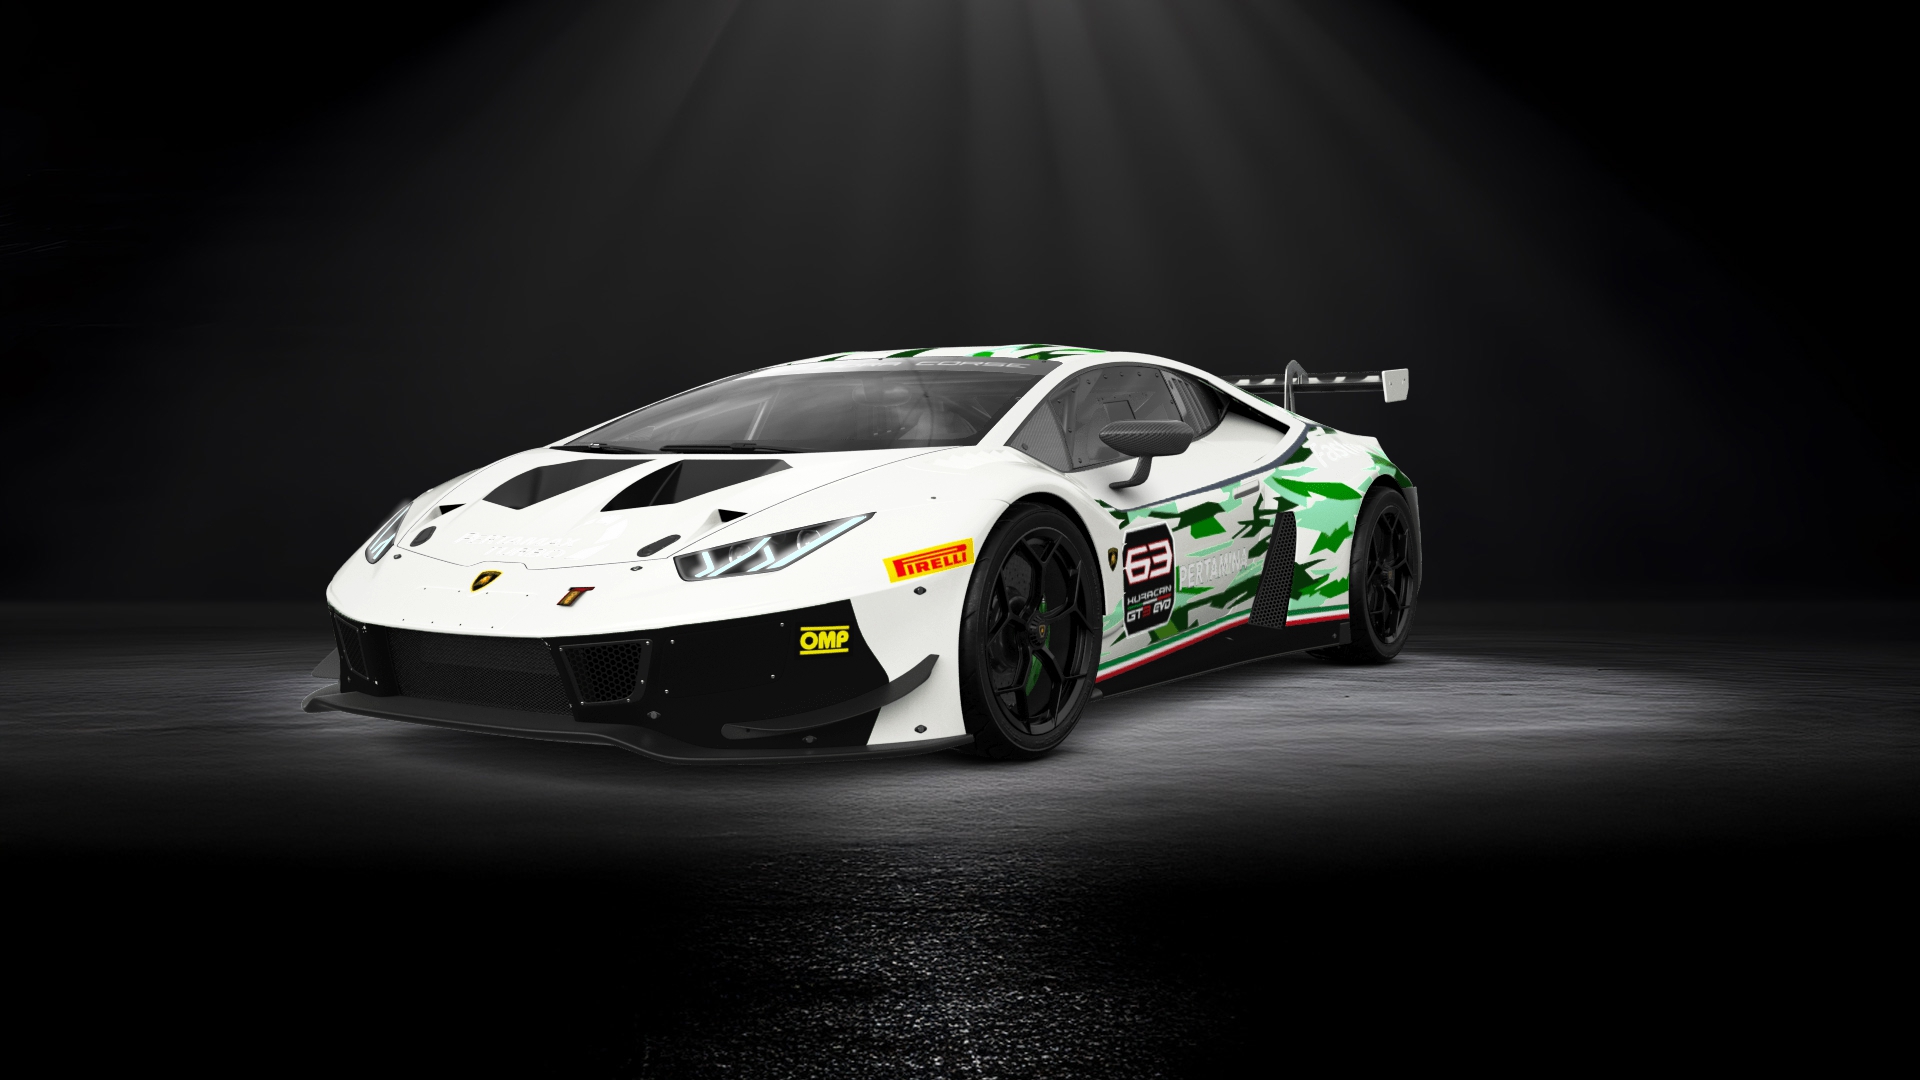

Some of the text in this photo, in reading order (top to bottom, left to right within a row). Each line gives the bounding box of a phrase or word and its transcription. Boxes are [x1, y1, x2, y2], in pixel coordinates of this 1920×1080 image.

[483, 546, 567, 559] TURBO
[893, 543, 967, 578] PIRELLI
[1126, 539, 1173, 586] 63
[1179, 547, 1248, 591] PERTAMINA
[800, 629, 849, 651] OMP
